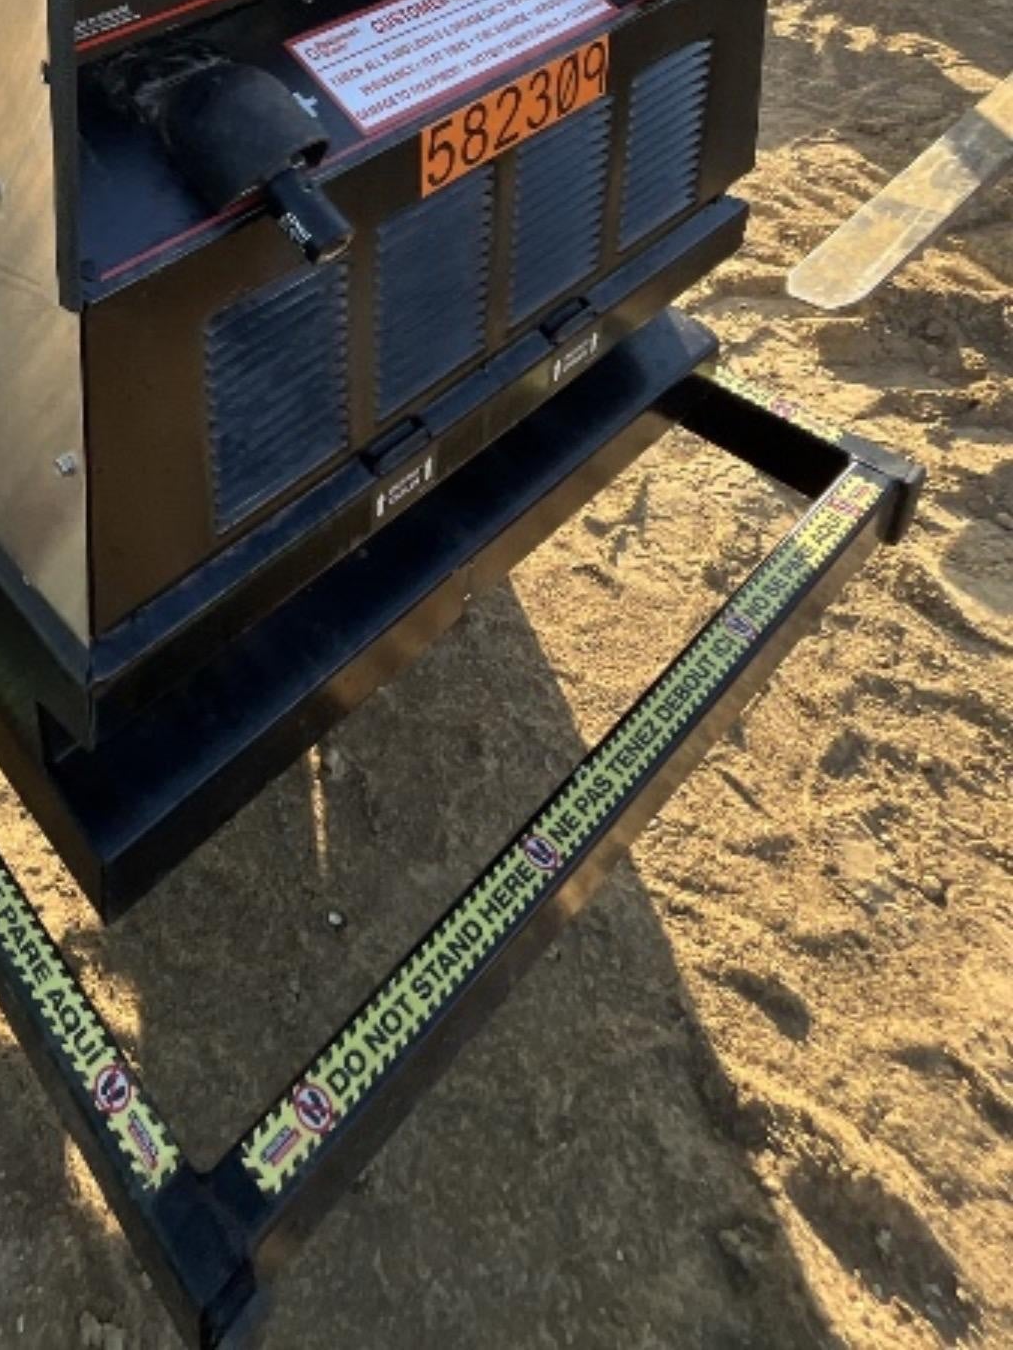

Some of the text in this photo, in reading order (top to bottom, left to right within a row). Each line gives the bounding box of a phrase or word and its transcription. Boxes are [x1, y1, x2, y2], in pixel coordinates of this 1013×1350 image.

[426, 42, 608, 191] 582309
[547, 634, 737, 847] NE PAS TENEZ DEBOUT ICI
[325, 859, 537, 1098] DO NOT STAND HERE
